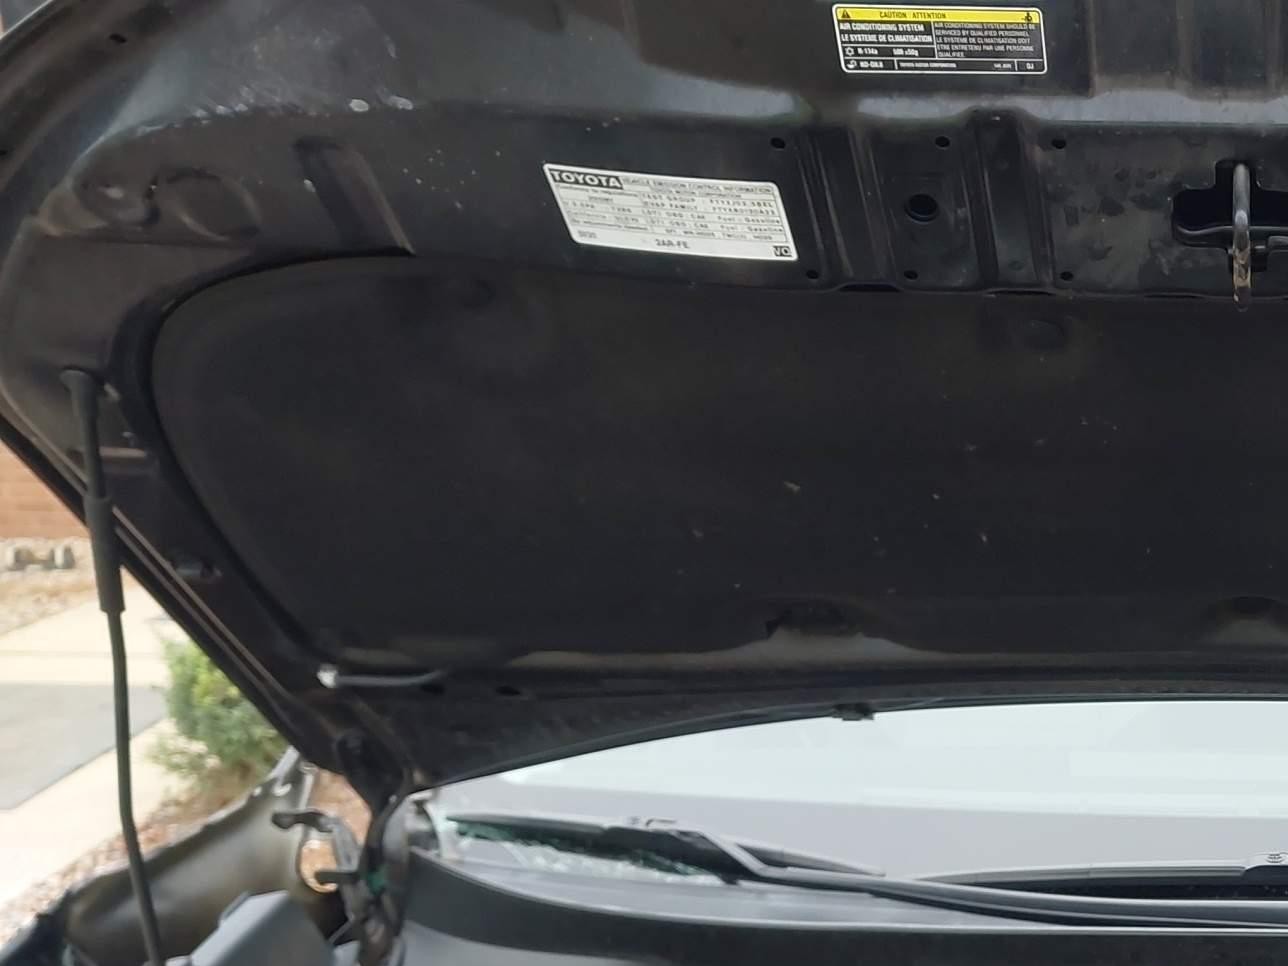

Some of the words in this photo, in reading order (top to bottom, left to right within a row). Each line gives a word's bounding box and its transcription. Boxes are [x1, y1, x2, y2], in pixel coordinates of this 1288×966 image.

[840, 22, 851, 30] AIR
[852, 23, 897, 31] CONDITIONING
[878, 34, 887, 42] DE
[551, 170, 621, 188] TOYOTA
